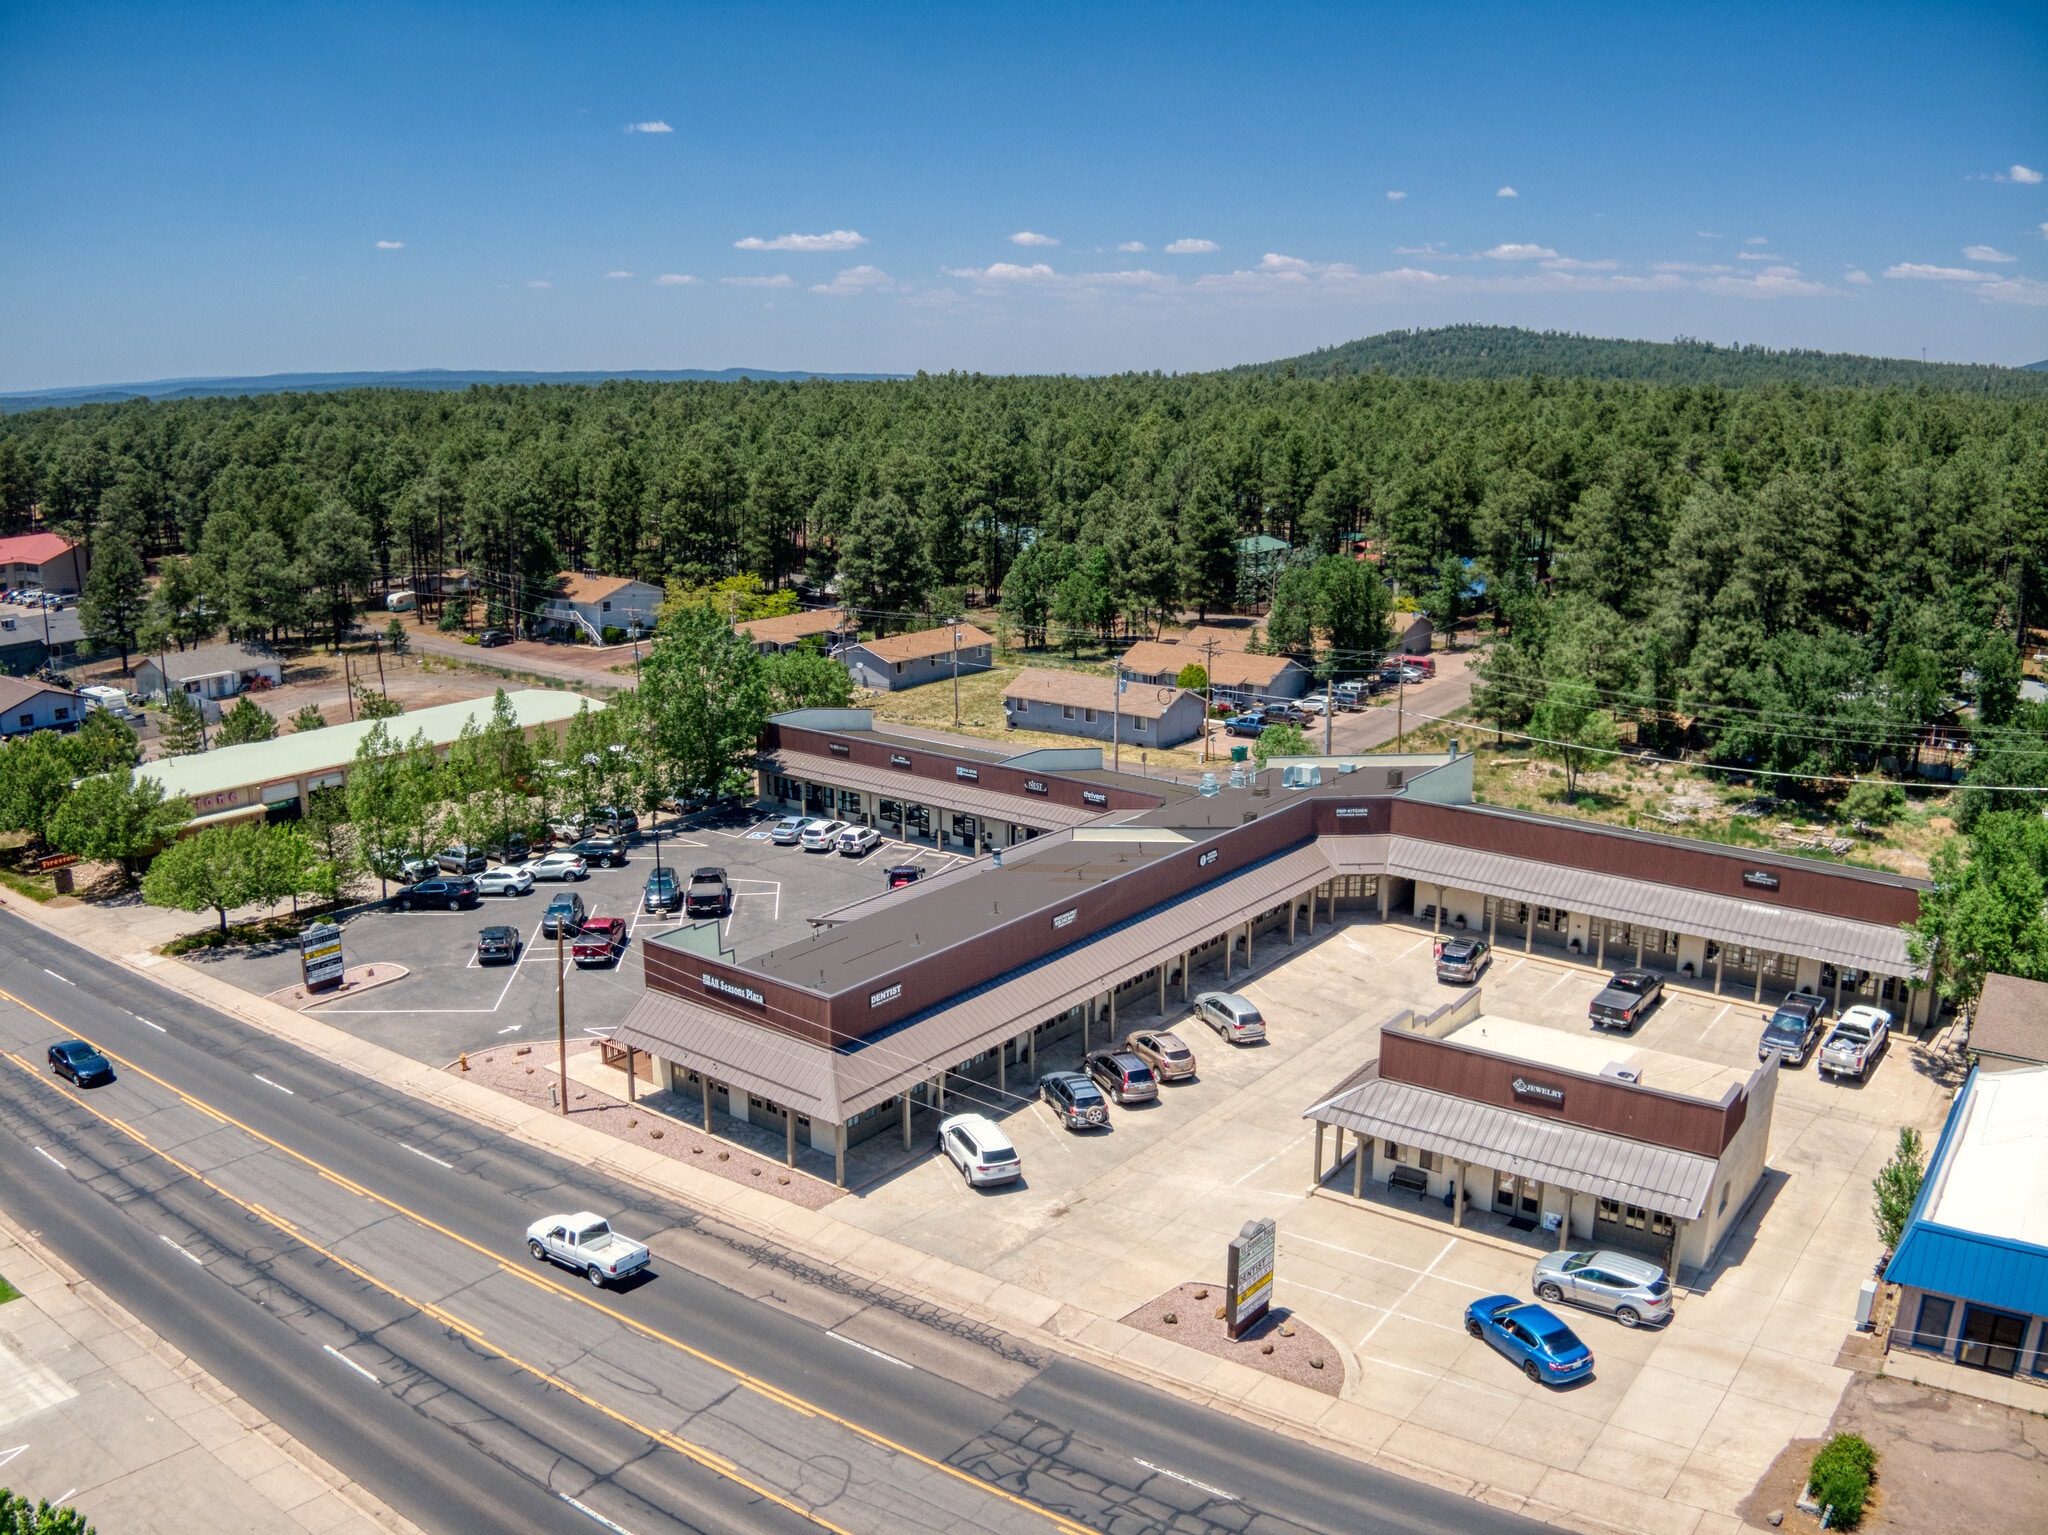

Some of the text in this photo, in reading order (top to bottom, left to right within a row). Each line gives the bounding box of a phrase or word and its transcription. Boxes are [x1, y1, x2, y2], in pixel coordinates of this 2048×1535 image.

[711, 977, 764, 1004] All Seasons Plaza
[871, 984, 902, 1004] DENTIST
[1526, 1084, 1564, 1098] JEWELRY
[1238, 1258, 1266, 1285] DENTIST
